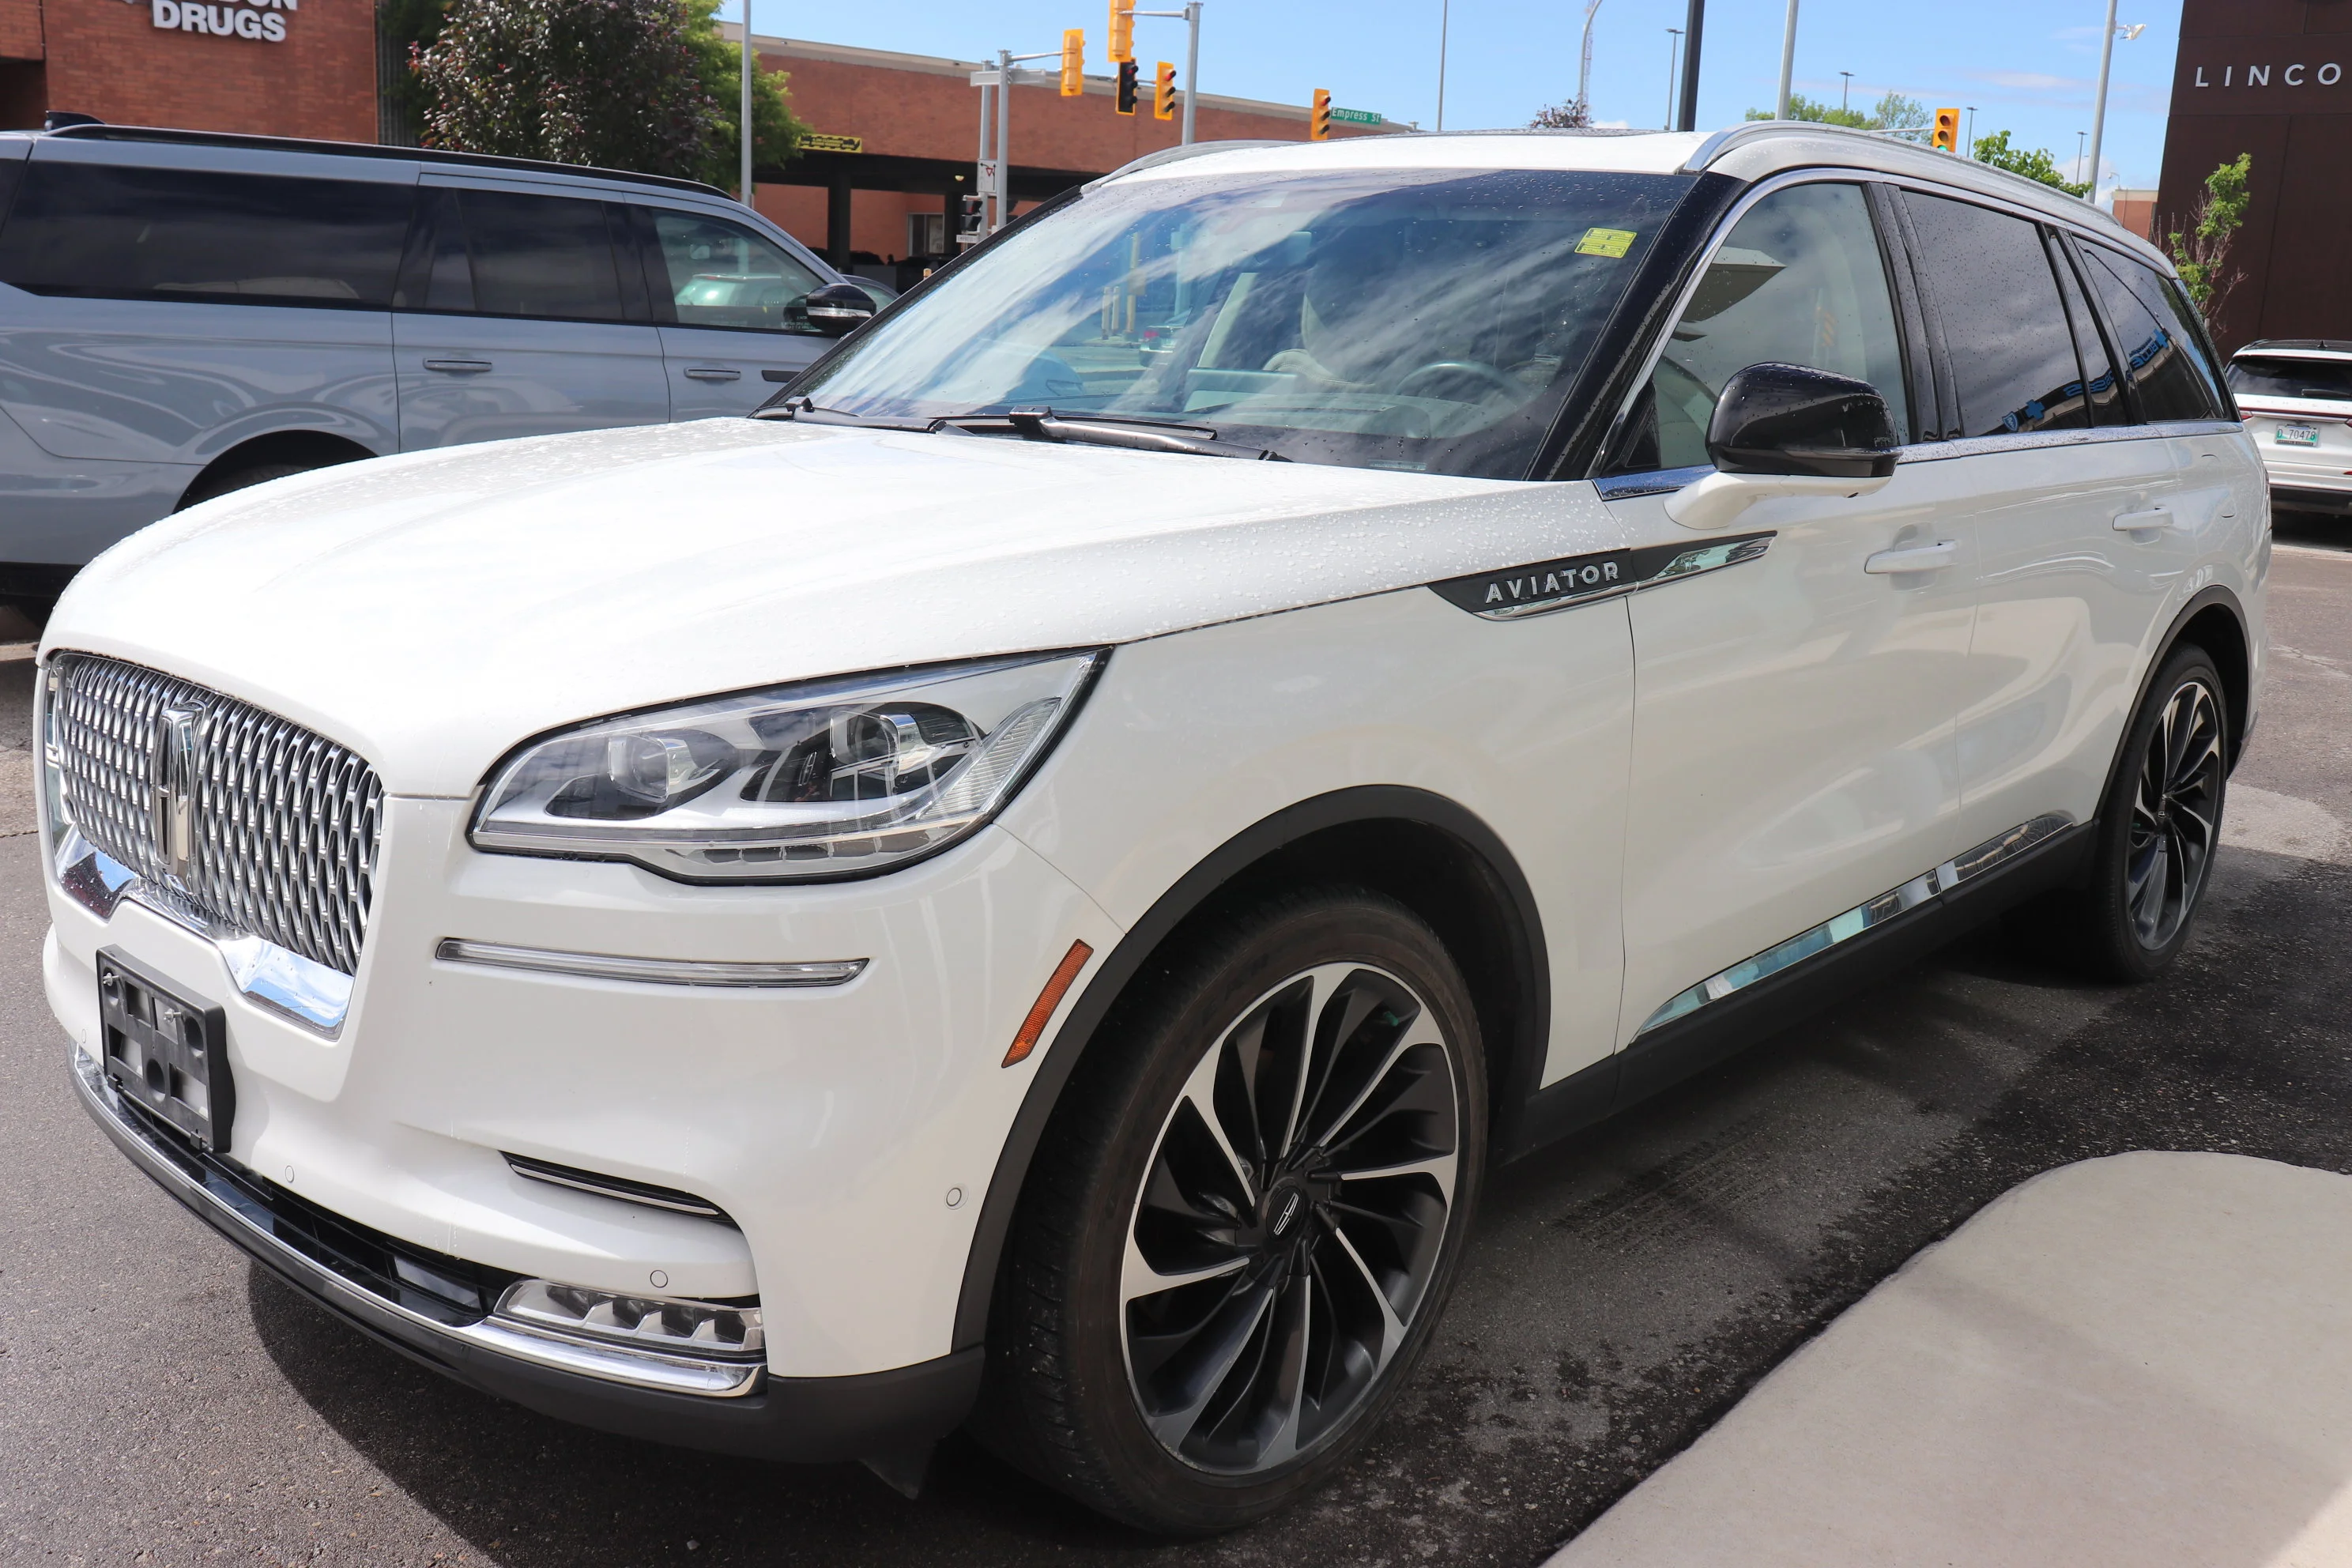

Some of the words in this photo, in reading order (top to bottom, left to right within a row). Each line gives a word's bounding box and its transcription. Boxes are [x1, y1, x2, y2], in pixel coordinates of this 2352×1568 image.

[153, 0, 287, 42] DRUGS
[2195, 62, 2342, 88] LINCO
[1332, 107, 1367, 121] Empress
[1371, 113, 1381, 122] St
[2289, 429, 2316, 440] 70478
[1485, 561, 1619, 604] AVIATOR
